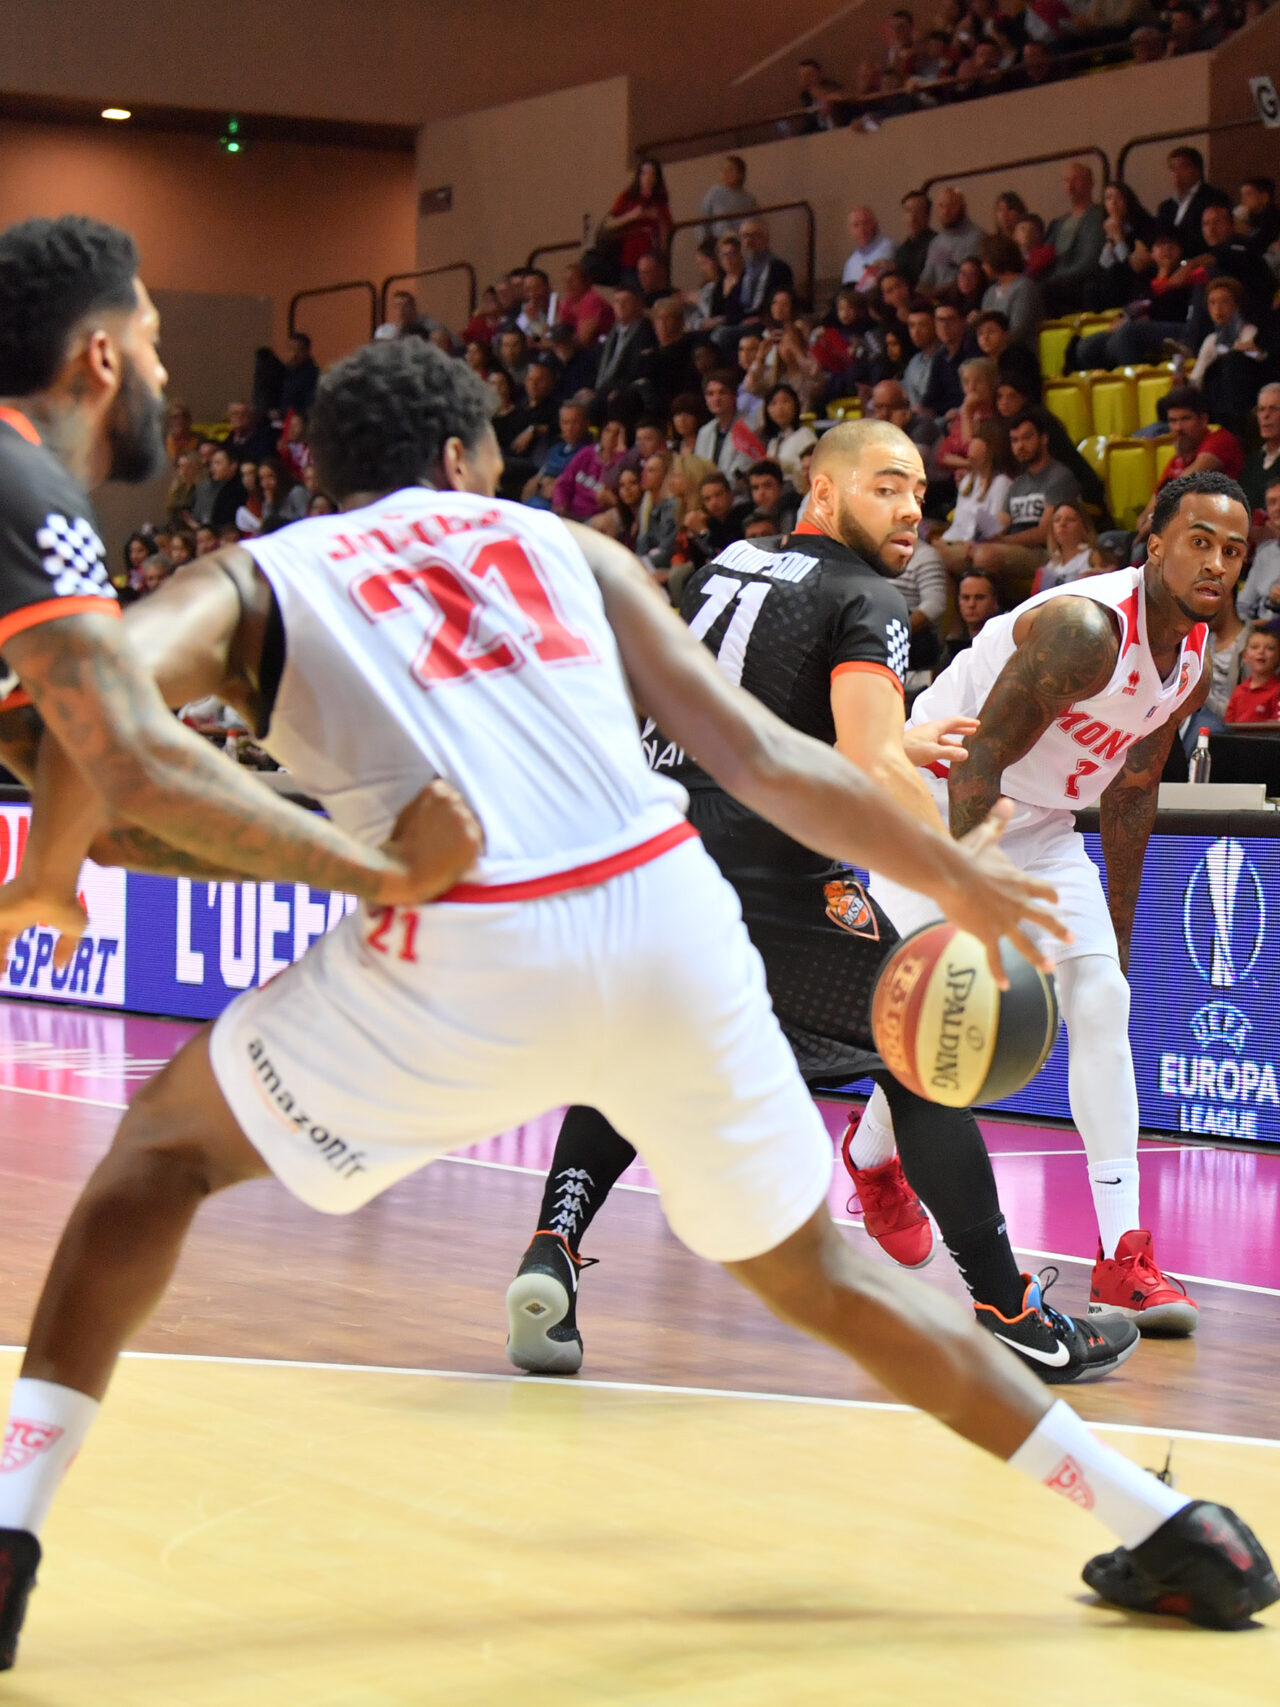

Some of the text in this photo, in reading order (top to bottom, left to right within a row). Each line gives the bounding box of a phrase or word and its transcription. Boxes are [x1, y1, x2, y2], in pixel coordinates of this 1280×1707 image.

[1256, 85, 1279, 119] G
[348, 534, 603, 691] 21
[687, 574, 772, 688] 71
[1064, 758, 1100, 799] 1
[366, 906, 420, 963] 21
[932, 963, 977, 1091] SPALDING
[1159, 1052, 1280, 1107] EUROPA
[1180, 1103, 1258, 1140] LEAGUE
